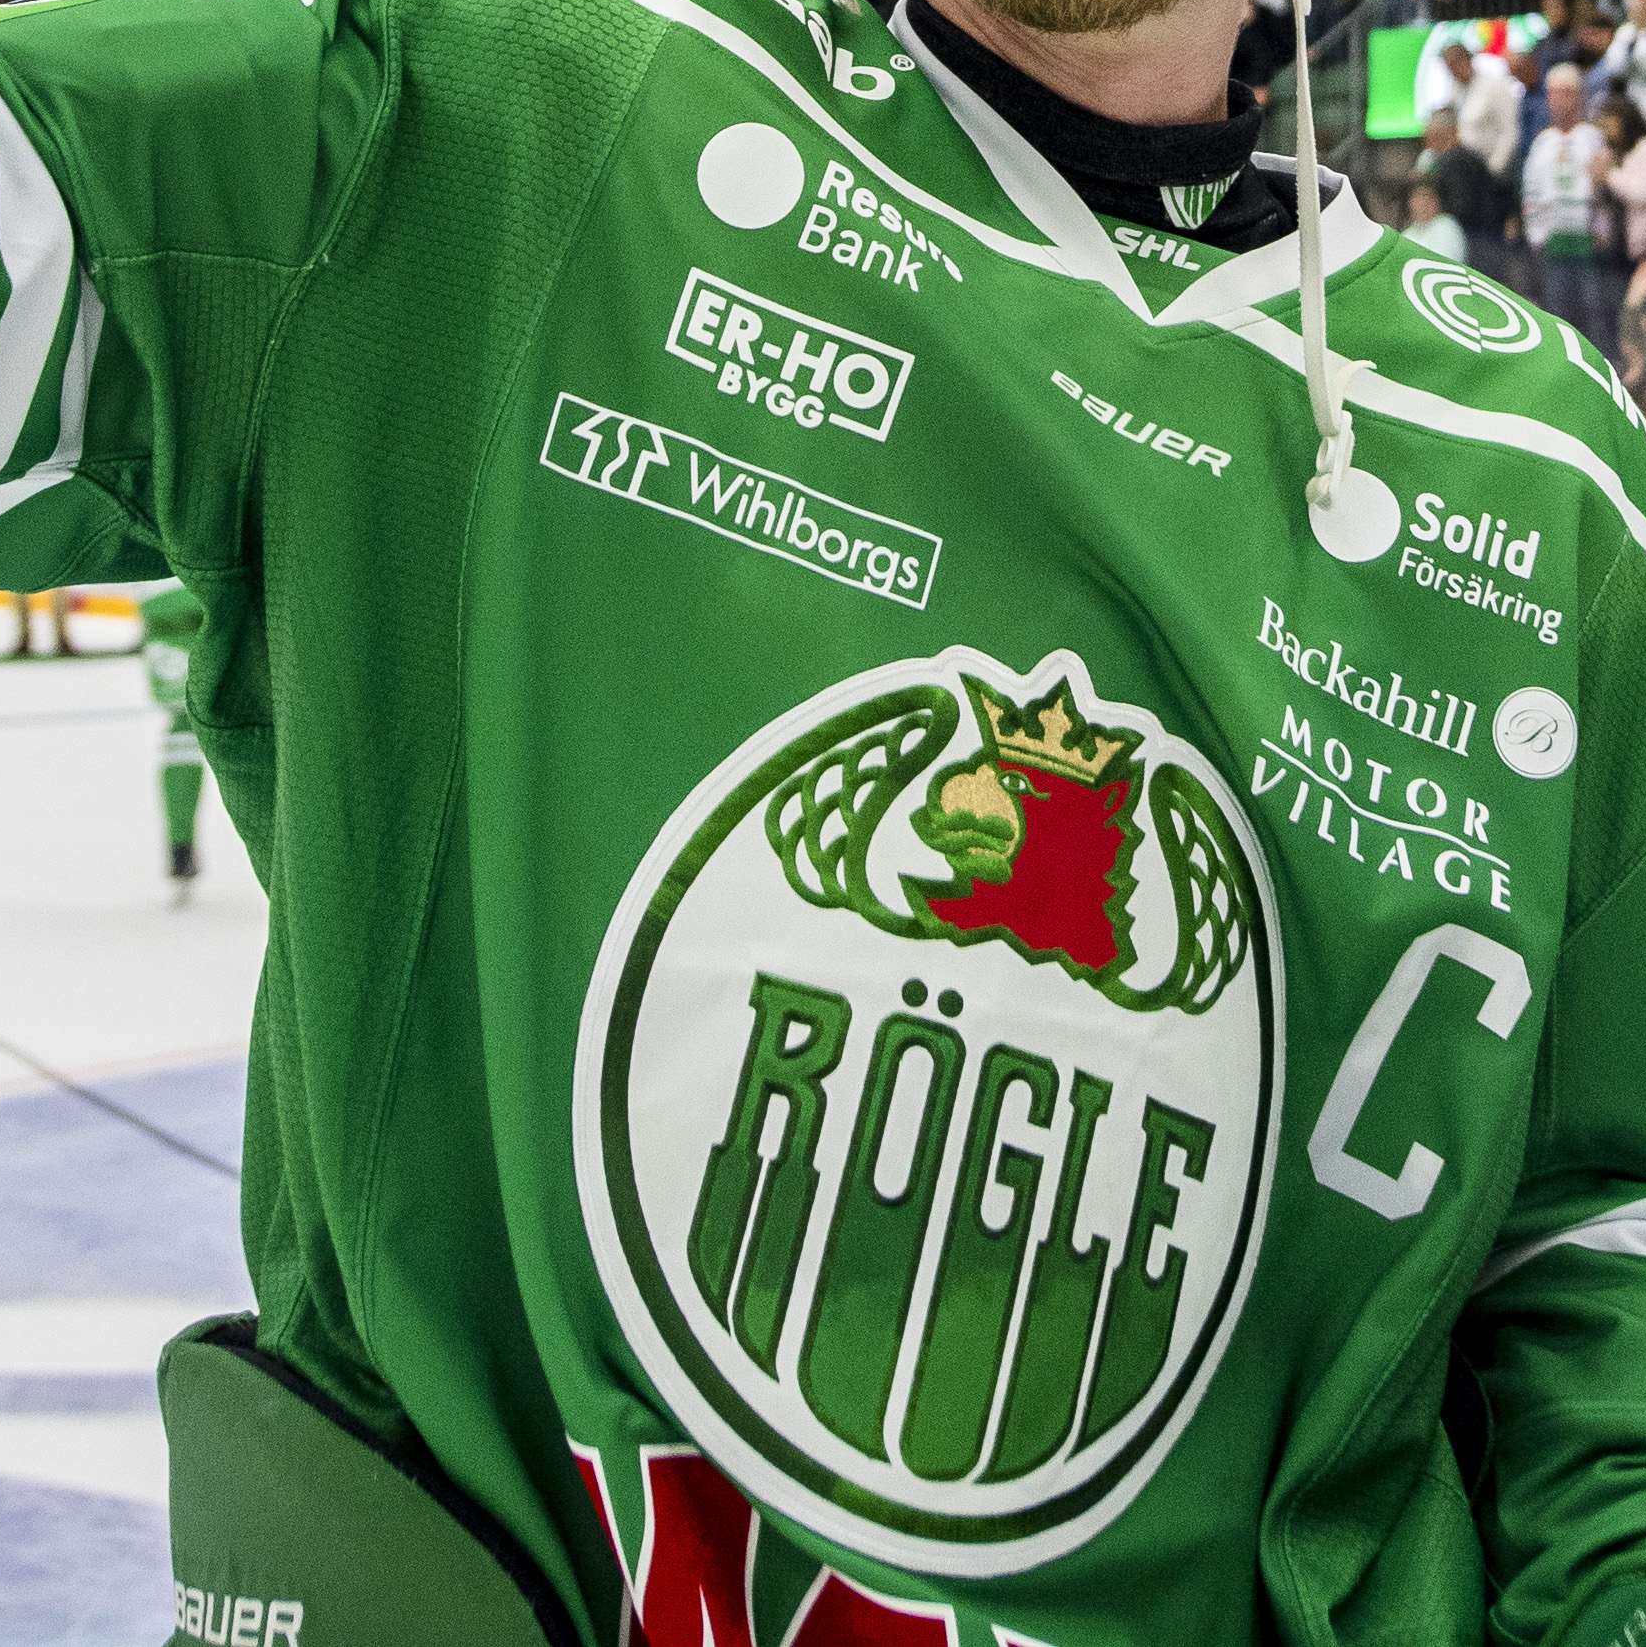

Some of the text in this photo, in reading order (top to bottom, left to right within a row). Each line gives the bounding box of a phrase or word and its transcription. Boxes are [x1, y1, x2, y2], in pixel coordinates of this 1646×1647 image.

[798, 204, 923, 293] Bank
[818, 159, 964, 283] Resurs
[1113, 226, 1202, 272] SHL
[685, 287, 890, 411] ER-HO
[717, 363, 825, 430] BYGG
[1049, 370, 1232, 478] BAUER
[690, 451, 920, 594] Wihlborgs
[1409, 492, 1541, 581] Solid
[1398, 546, 1563, 646] Försäkring
[1256, 596, 1478, 757] Backahill
[1251, 756, 1513, 915] VILLAGE
[1280, 704, 1491, 846] MOTOR
[1308, 923, 1531, 1221] C
[686, 970, 1215, 1485] RÖGLE
[175, 1580, 303, 1647] BAUER
